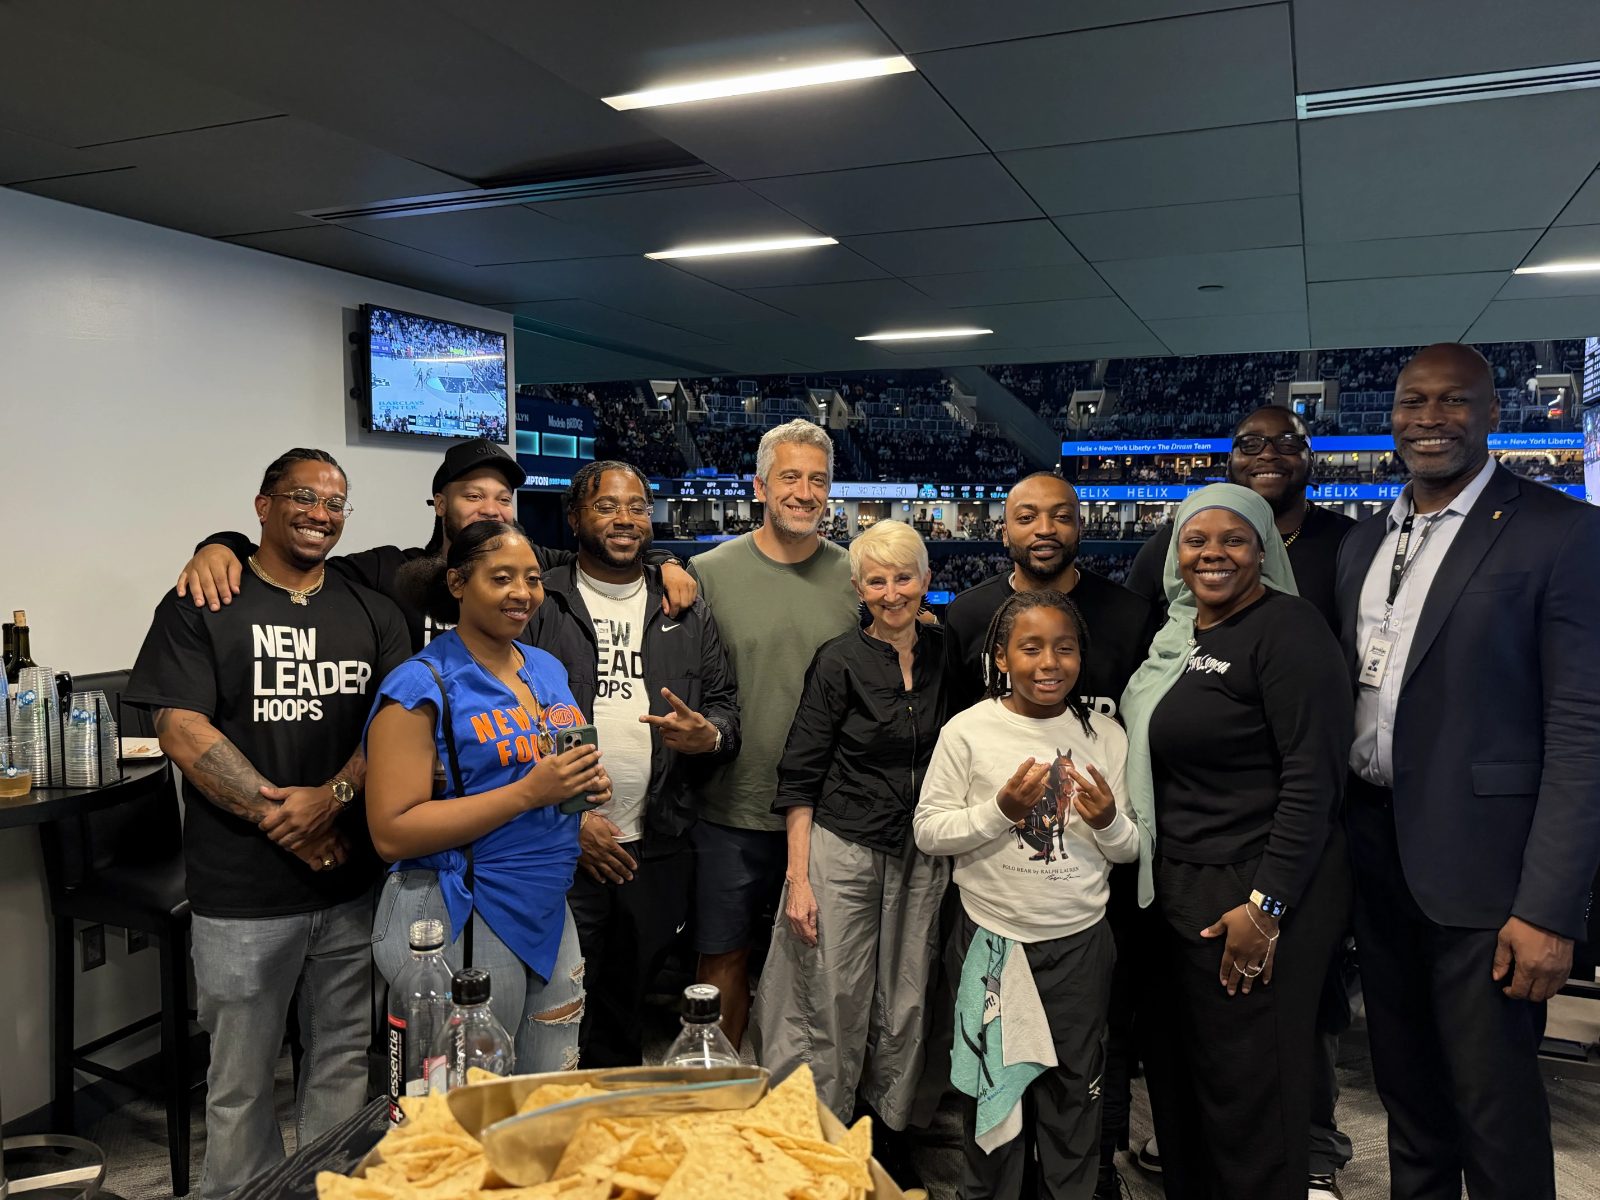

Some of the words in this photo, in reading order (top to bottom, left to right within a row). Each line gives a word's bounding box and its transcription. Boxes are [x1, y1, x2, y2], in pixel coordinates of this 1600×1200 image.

[703, 488, 720, 496] 4/13
[896, 486, 907, 497] 50
[1079, 488, 1109, 498] ELIX
[1127, 488, 1168, 498] HELIX
[1313, 486, 1358, 497] HELIX
[252, 624, 316, 661] NEW
[593, 618, 631, 647] EW
[254, 660, 372, 697] LEADER
[253, 698, 324, 722] HOOPS
[470, 706, 531, 744] NEW
[1060, 866, 1080, 874] LAUREN
[390, 1029, 399, 1097] essentia
[455, 1024, 466, 1087] essentia
